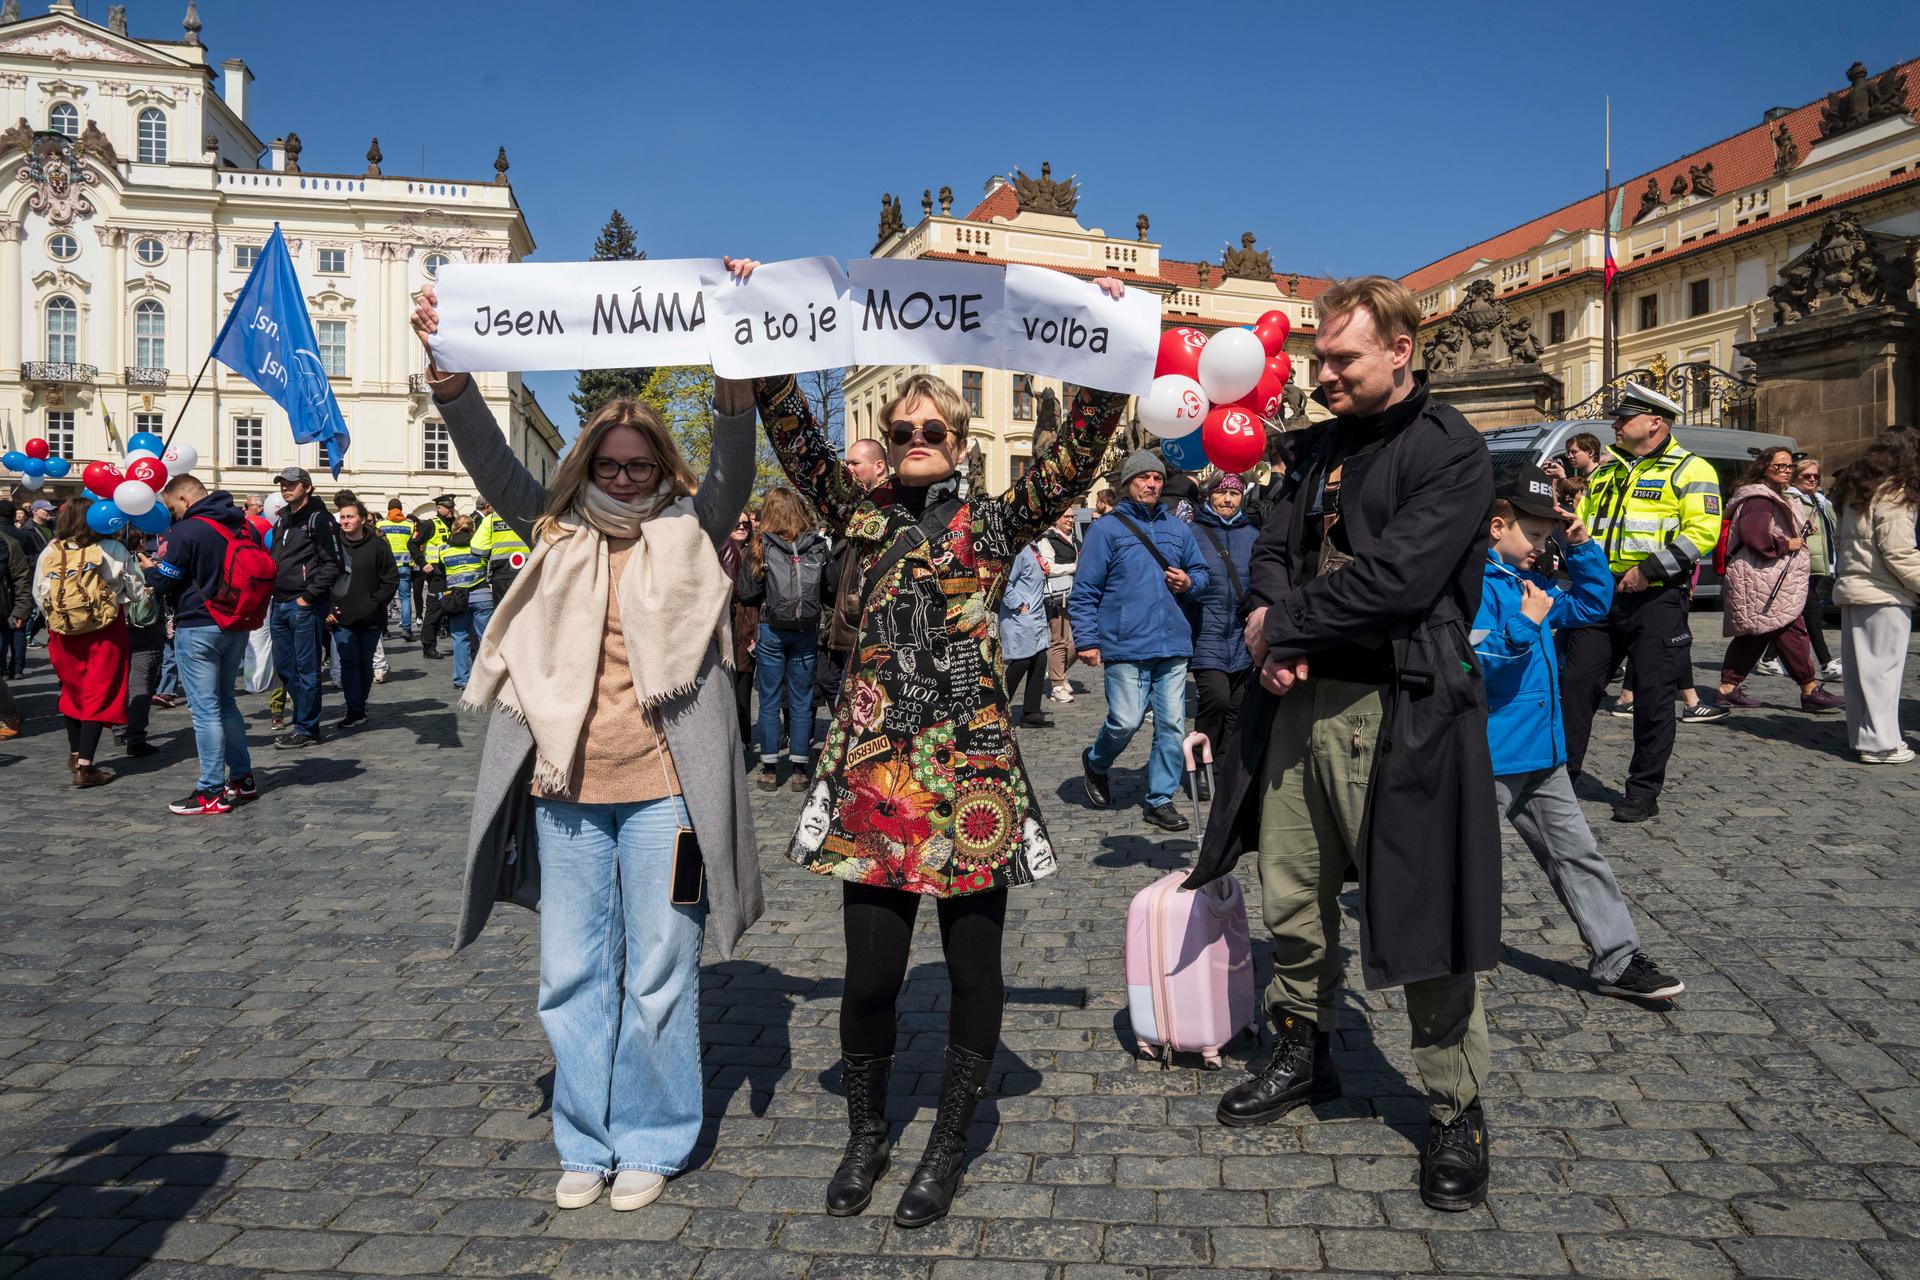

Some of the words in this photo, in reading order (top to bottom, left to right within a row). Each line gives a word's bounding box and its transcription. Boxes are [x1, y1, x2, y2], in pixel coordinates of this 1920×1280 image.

[474, 305, 564, 336] Jsem
[592, 286, 705, 335] MÁMA
[734, 318, 753, 345] a
[862, 288, 983, 333] MOJE
[1022, 317, 1109, 353] volba
